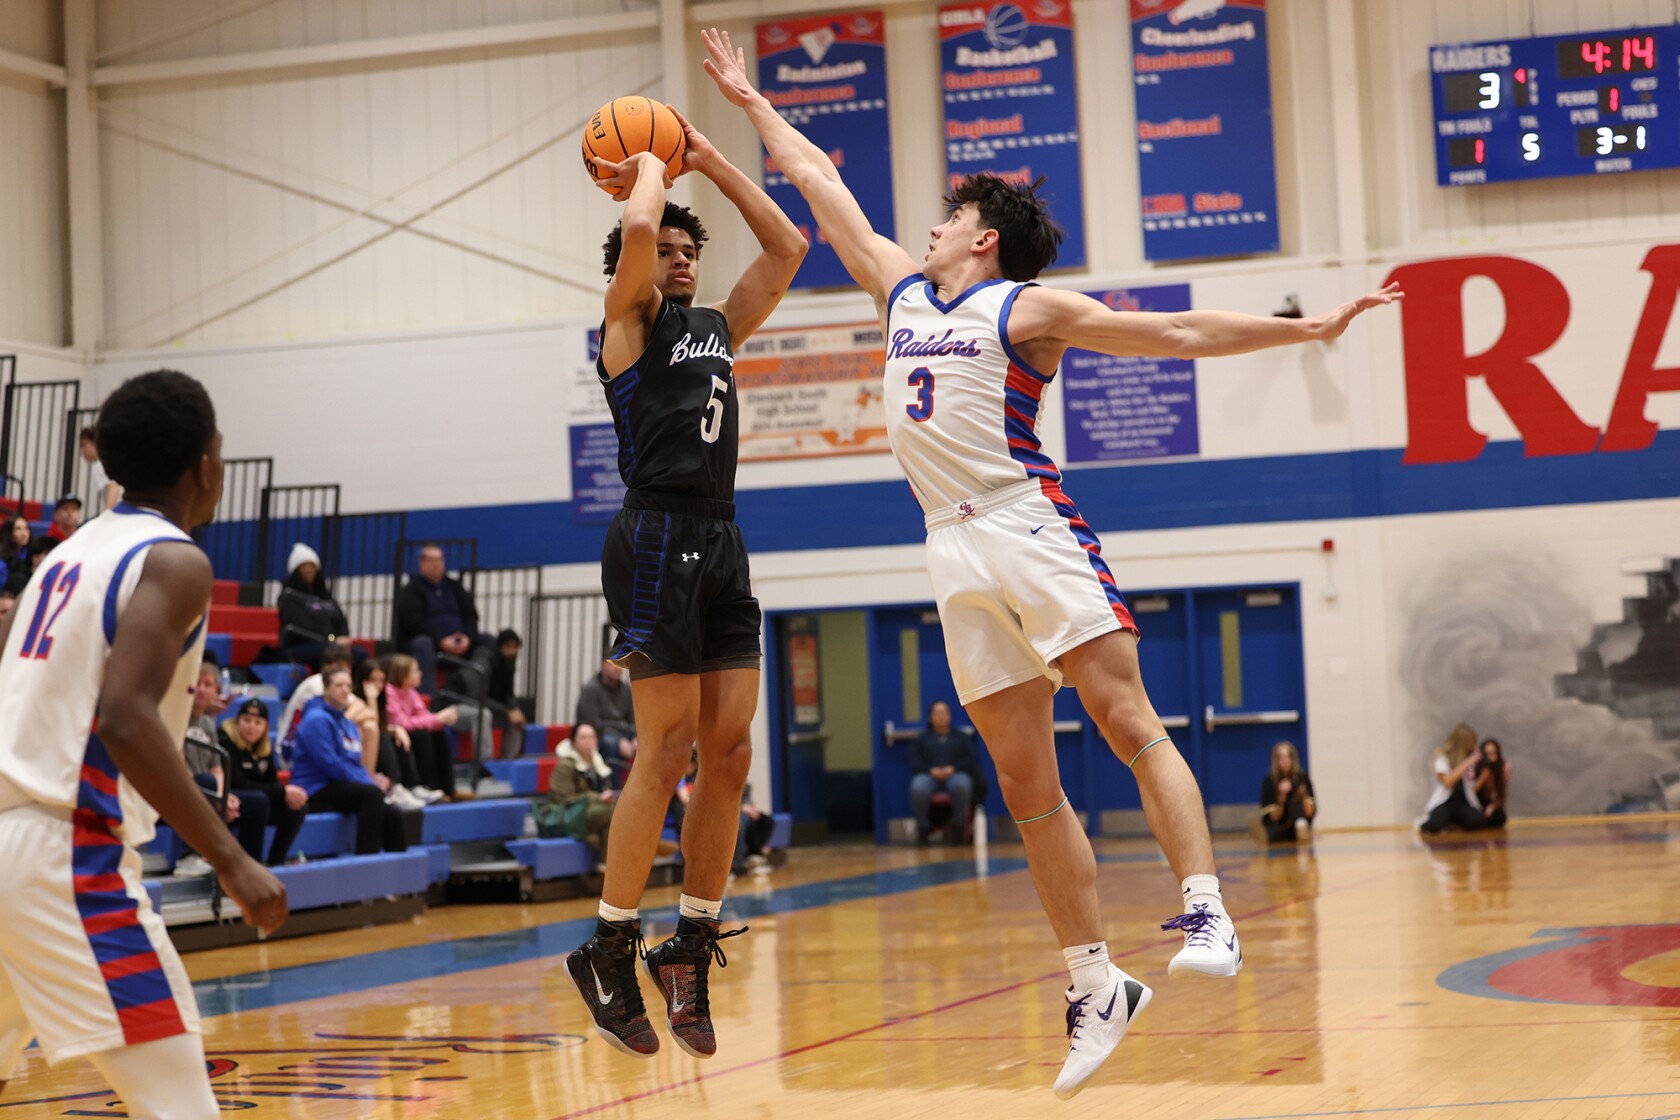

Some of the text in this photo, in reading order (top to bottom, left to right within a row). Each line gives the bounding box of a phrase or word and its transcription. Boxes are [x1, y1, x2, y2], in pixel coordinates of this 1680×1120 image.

[1141, 21, 1255, 47] Cheerleading
[955, 38, 1058, 68] Basketball
[1432, 44, 1512, 72] RAIDERS
[1582, 36, 1655, 74] 4:14
[1478, 72, 1501, 109] 3
[1609, 87, 1619, 112] 1
[1474, 138, 1485, 164] 1
[1521, 132, 1541, 162] 5
[887, 328, 981, 360] Raiders
[700, 374, 728, 443] 5
[906, 366, 935, 422] 3
[20, 561, 82, 660] 12
